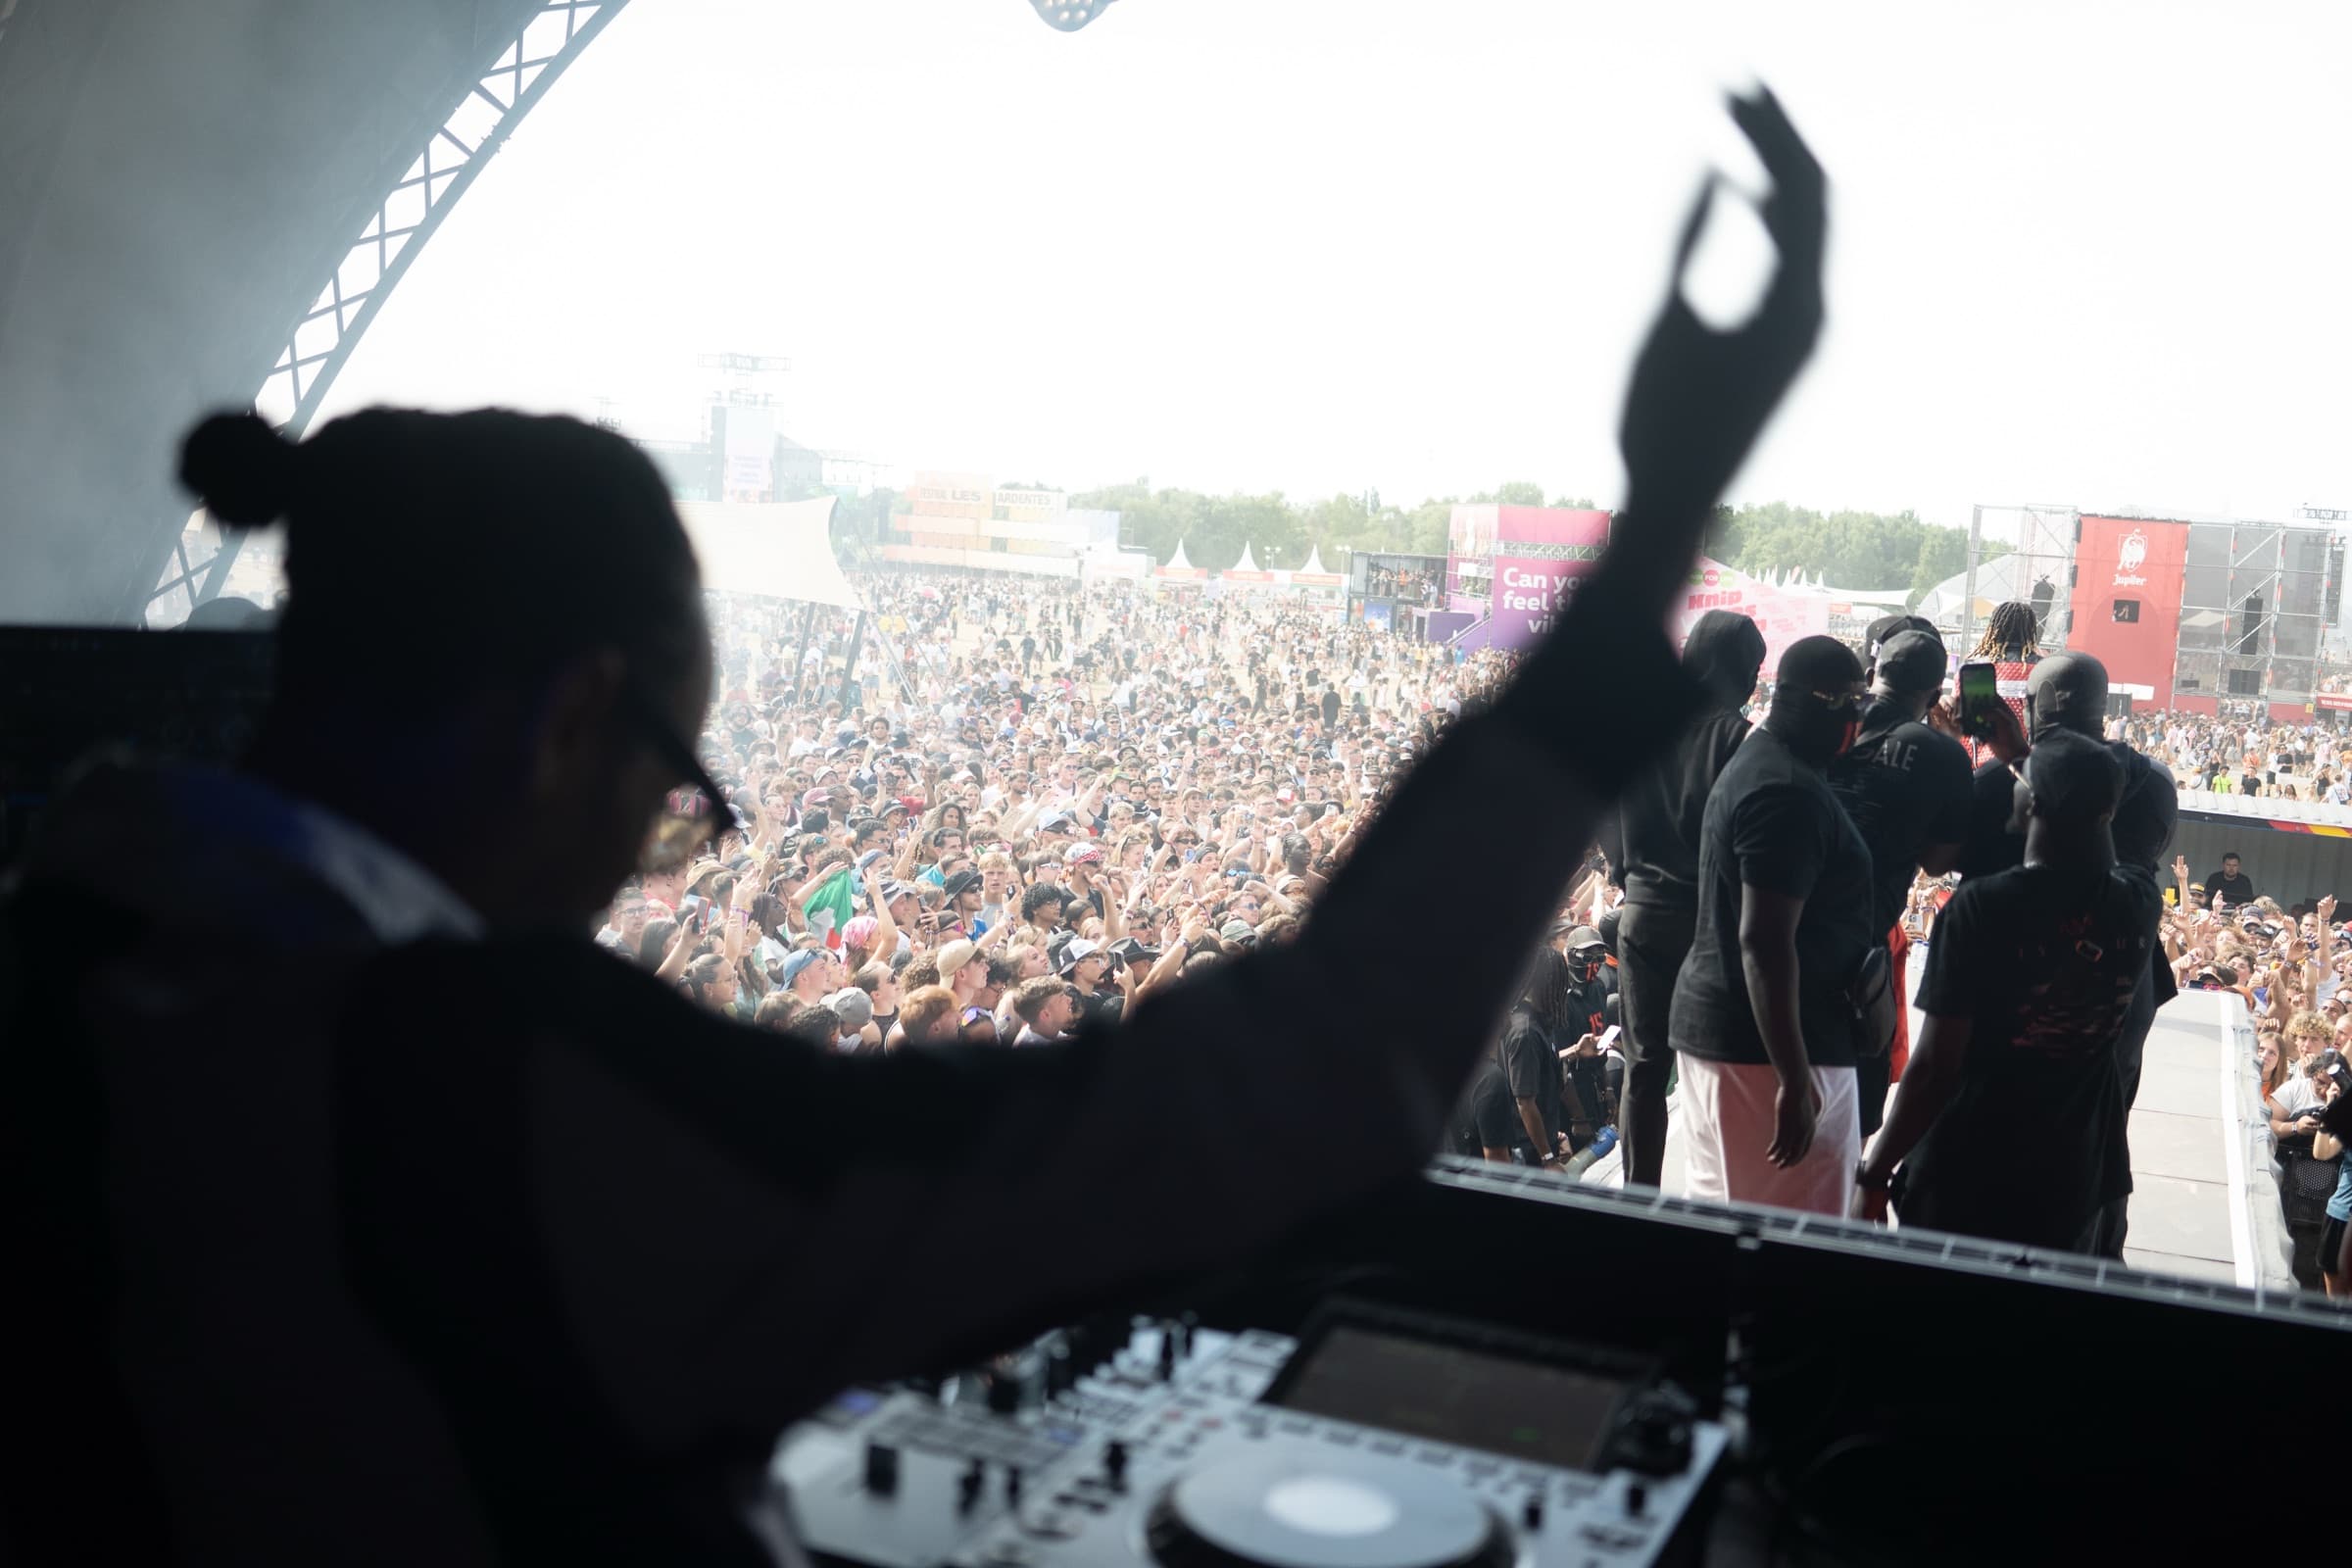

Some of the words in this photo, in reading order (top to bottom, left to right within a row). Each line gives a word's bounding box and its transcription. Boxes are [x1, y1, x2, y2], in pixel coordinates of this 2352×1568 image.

[952, 488, 981, 503] LES
[998, 492, 1052, 505] ARDENTES
[1502, 567, 1547, 588] Can
[1553, 575, 1588, 594] yo
[1502, 590, 1549, 612] feel
